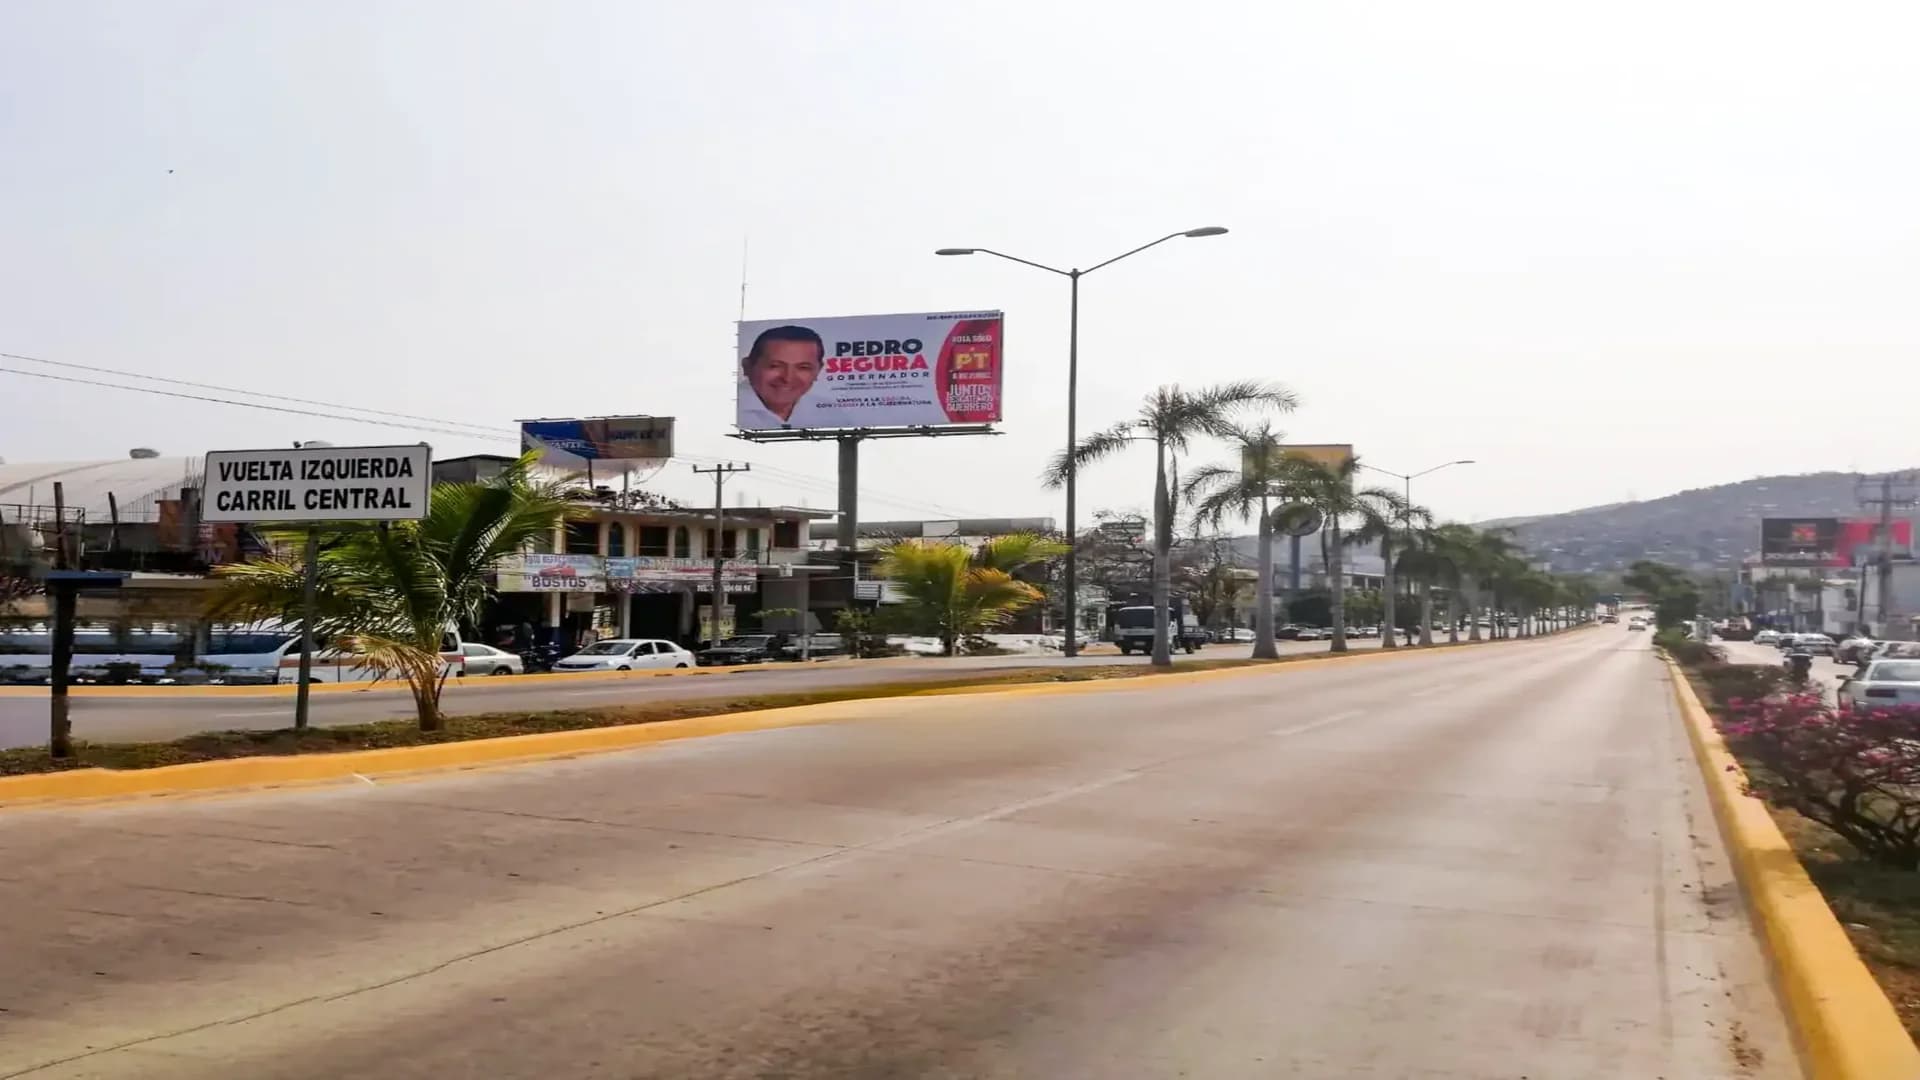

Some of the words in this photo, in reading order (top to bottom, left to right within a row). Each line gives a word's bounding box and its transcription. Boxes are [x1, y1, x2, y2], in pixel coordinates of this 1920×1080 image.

[836, 338, 923, 357] PEDRO
[826, 354, 929, 373] SEGURA
[954, 352, 989, 369] PT
[827, 372, 929, 381] GOBERNADOR
[950, 384, 992, 395] JUNTOS
[946, 402, 993, 412] GUERRERO
[219, 460, 294, 482] VUELTA
[300, 457, 413, 481] IZQUIERDA
[216, 489, 296, 511] CARRIL
[303, 487, 412, 510] CENTRAL
